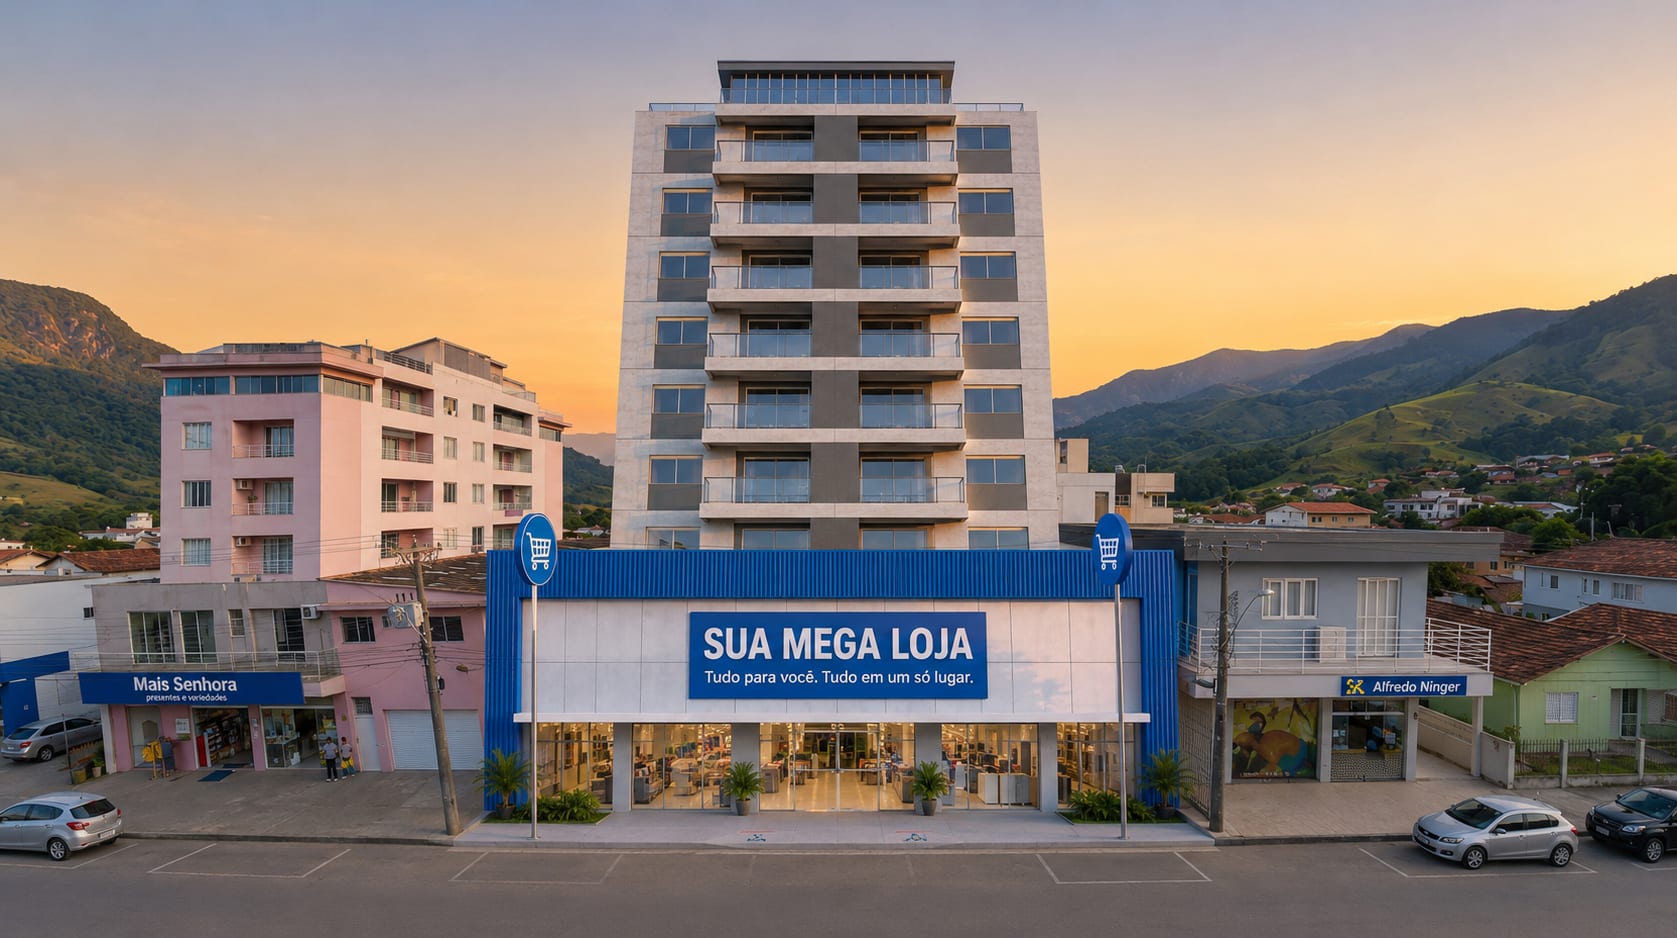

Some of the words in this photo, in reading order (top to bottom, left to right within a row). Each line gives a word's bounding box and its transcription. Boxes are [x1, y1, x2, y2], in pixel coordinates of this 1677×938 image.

[703, 627, 772, 660] SUA
[784, 627, 881, 660] MEGA
[893, 627, 974, 660] LOJA
[133, 676, 170, 692] Mais
[173, 676, 237, 692] Senhora
[704, 670, 741, 684] Tudo
[744, 673, 776, 687] para
[780, 670, 818, 684] você.
[822, 669, 858, 684] Tudo
[861, 673, 884, 684] em
[887, 673, 910, 684] um
[914, 670, 931, 684] só
[935, 669, 974, 687] lugar.
[1372, 680, 1417, 693] Alfredo
[1420, 680, 1461, 695] Ninger
